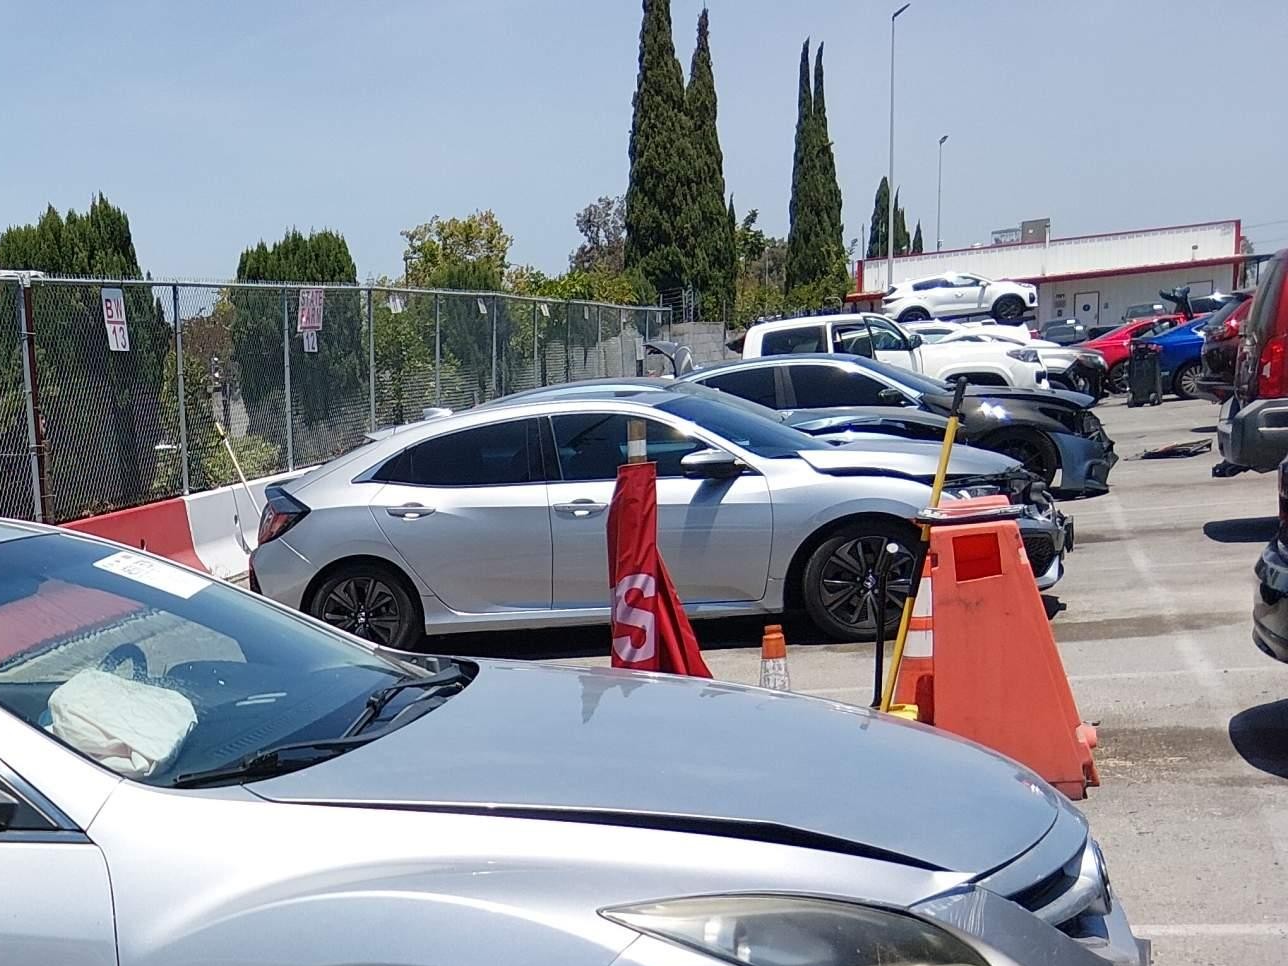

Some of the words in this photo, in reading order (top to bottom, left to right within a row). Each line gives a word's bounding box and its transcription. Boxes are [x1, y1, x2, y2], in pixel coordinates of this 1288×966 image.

[300, 290, 323, 307] STATE
[104, 298, 123, 320] BW
[300, 307, 322, 326] FARM
[111, 326, 127, 350] 13
[305, 332, 316, 351] 12
[612, 573, 657, 663] S
